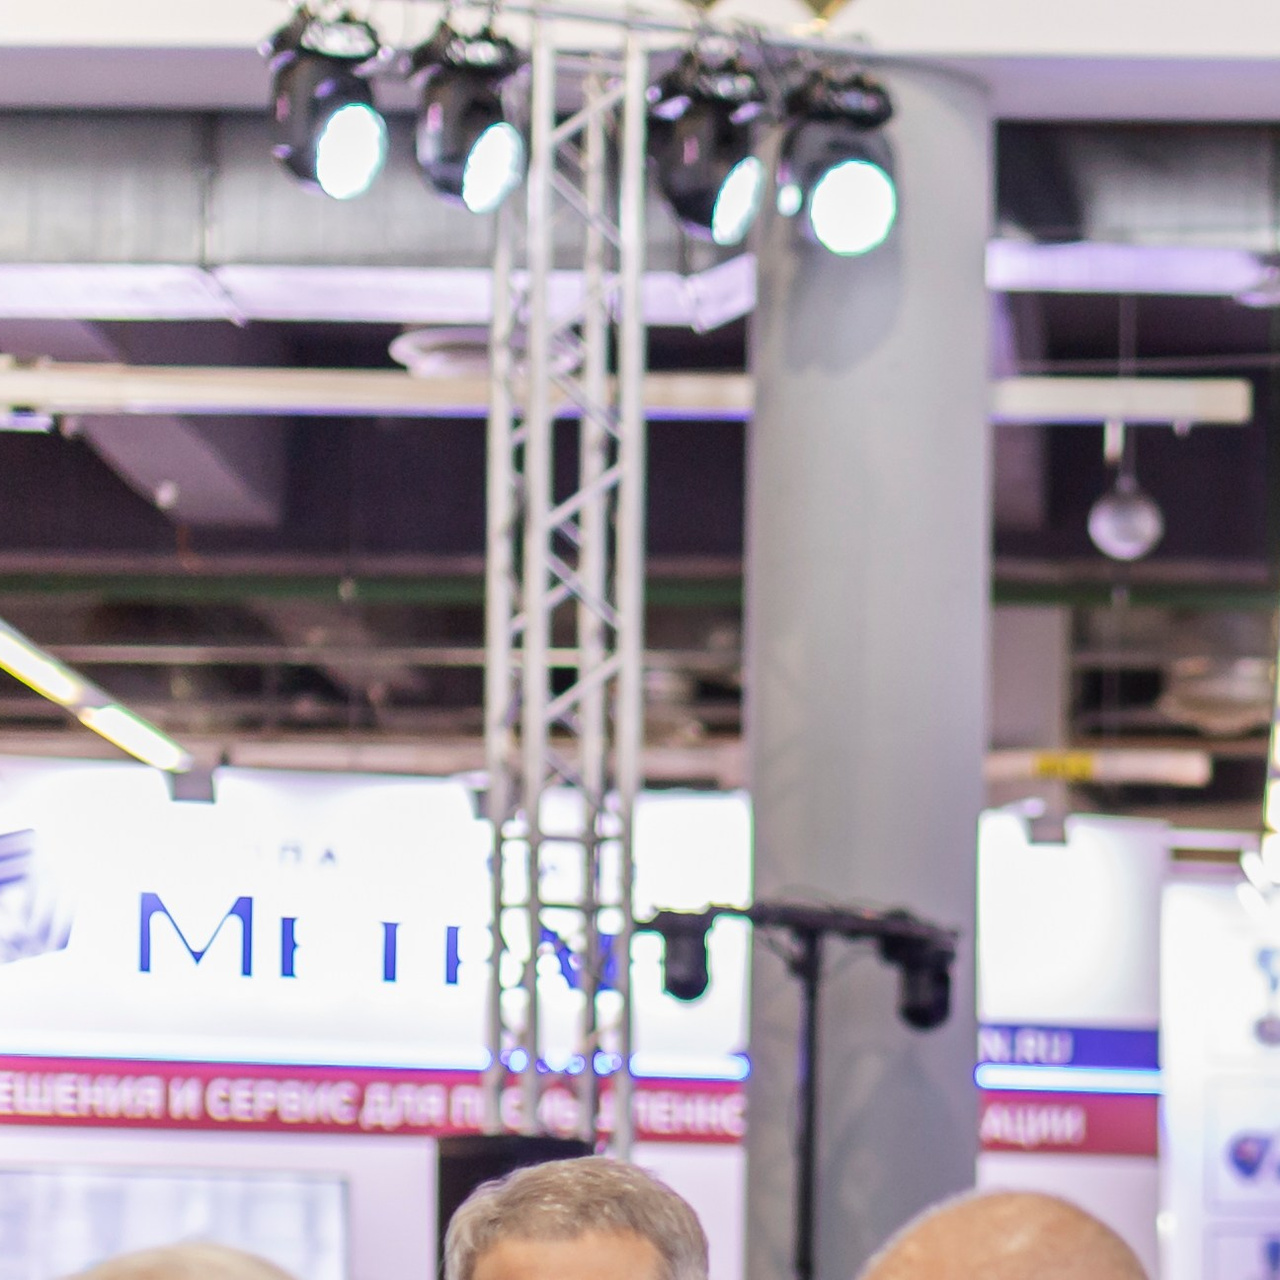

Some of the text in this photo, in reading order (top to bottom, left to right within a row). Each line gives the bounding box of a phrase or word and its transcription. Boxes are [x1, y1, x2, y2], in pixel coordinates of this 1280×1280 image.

[168, 1076, 202, 1120] И
[205, 1077, 360, 1125] СЕРВИС
[360, 1082, 447, 1131] ДЛЯ
